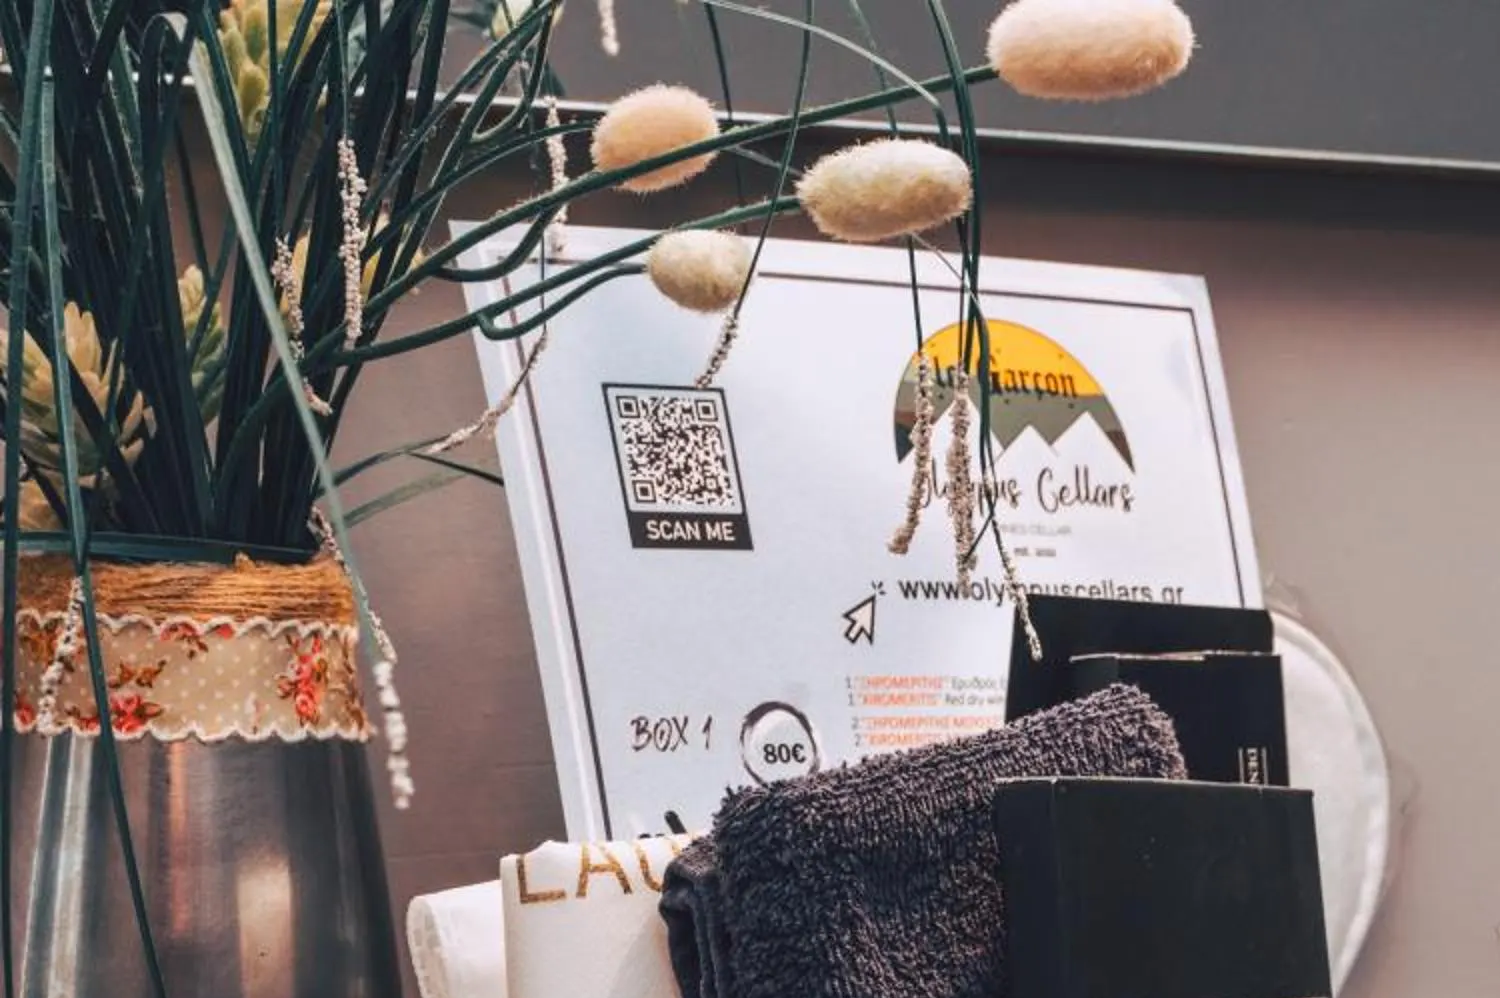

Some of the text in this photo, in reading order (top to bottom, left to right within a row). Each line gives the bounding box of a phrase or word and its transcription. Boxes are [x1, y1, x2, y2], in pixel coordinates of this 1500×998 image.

[1037, 465, 1134, 513] Cellars
[646, 519, 736, 542] SCAN ME
[898, 576, 1184, 607] wwwolyuscellarsgr
[630, 714, 713, 752] BOX 1
[763, 743, 806, 764] 80€
